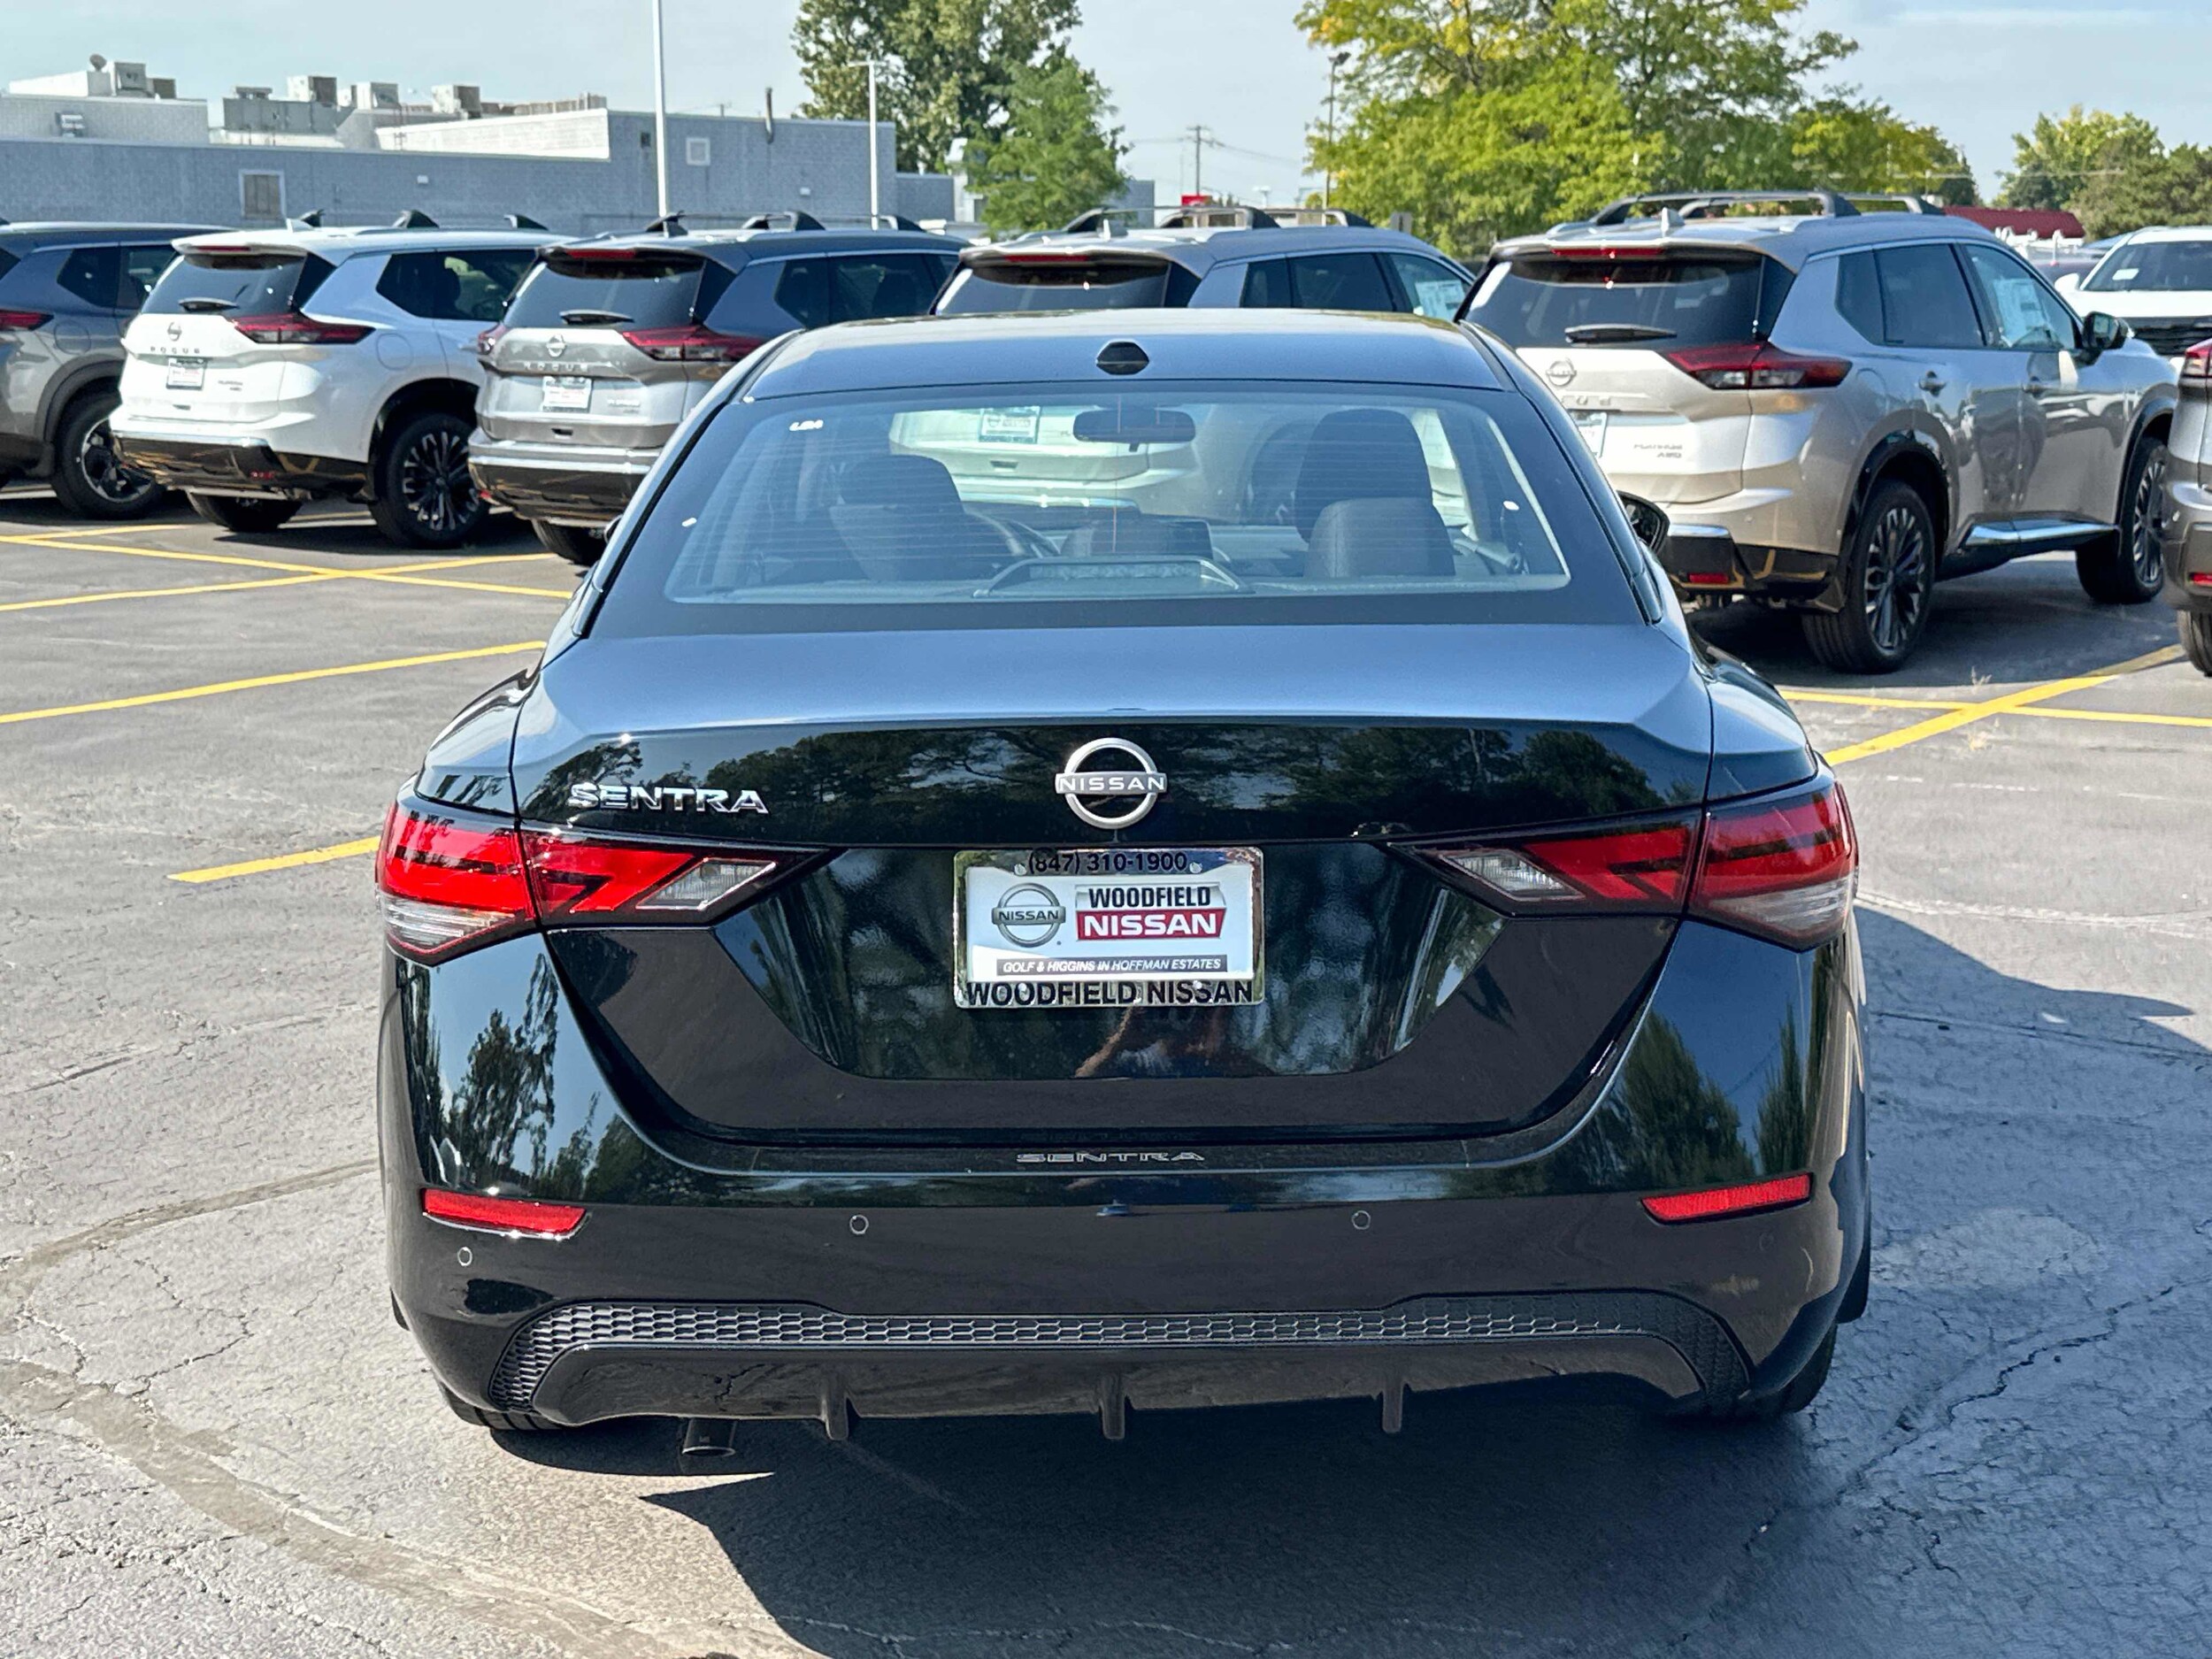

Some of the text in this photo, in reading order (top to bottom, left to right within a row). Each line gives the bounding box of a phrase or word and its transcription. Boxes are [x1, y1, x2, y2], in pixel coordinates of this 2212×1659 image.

[1059, 776, 1165, 792] NISSAN
[566, 782, 769, 814] SENTRA
[1029, 849, 1187, 874] (847) 310-1900
[1088, 887, 1211, 909] WOODFIELD
[998, 910, 1059, 921] NISSAN
[1084, 913, 1217, 937] NISSAN
[1002, 958, 1221, 973] GOLF & HIGGINS IN HOFFMAN ESTATES
[966, 979, 1253, 1006] WOODFIELD NISSAN
[1017, 1152, 1205, 1163] SENTRA
